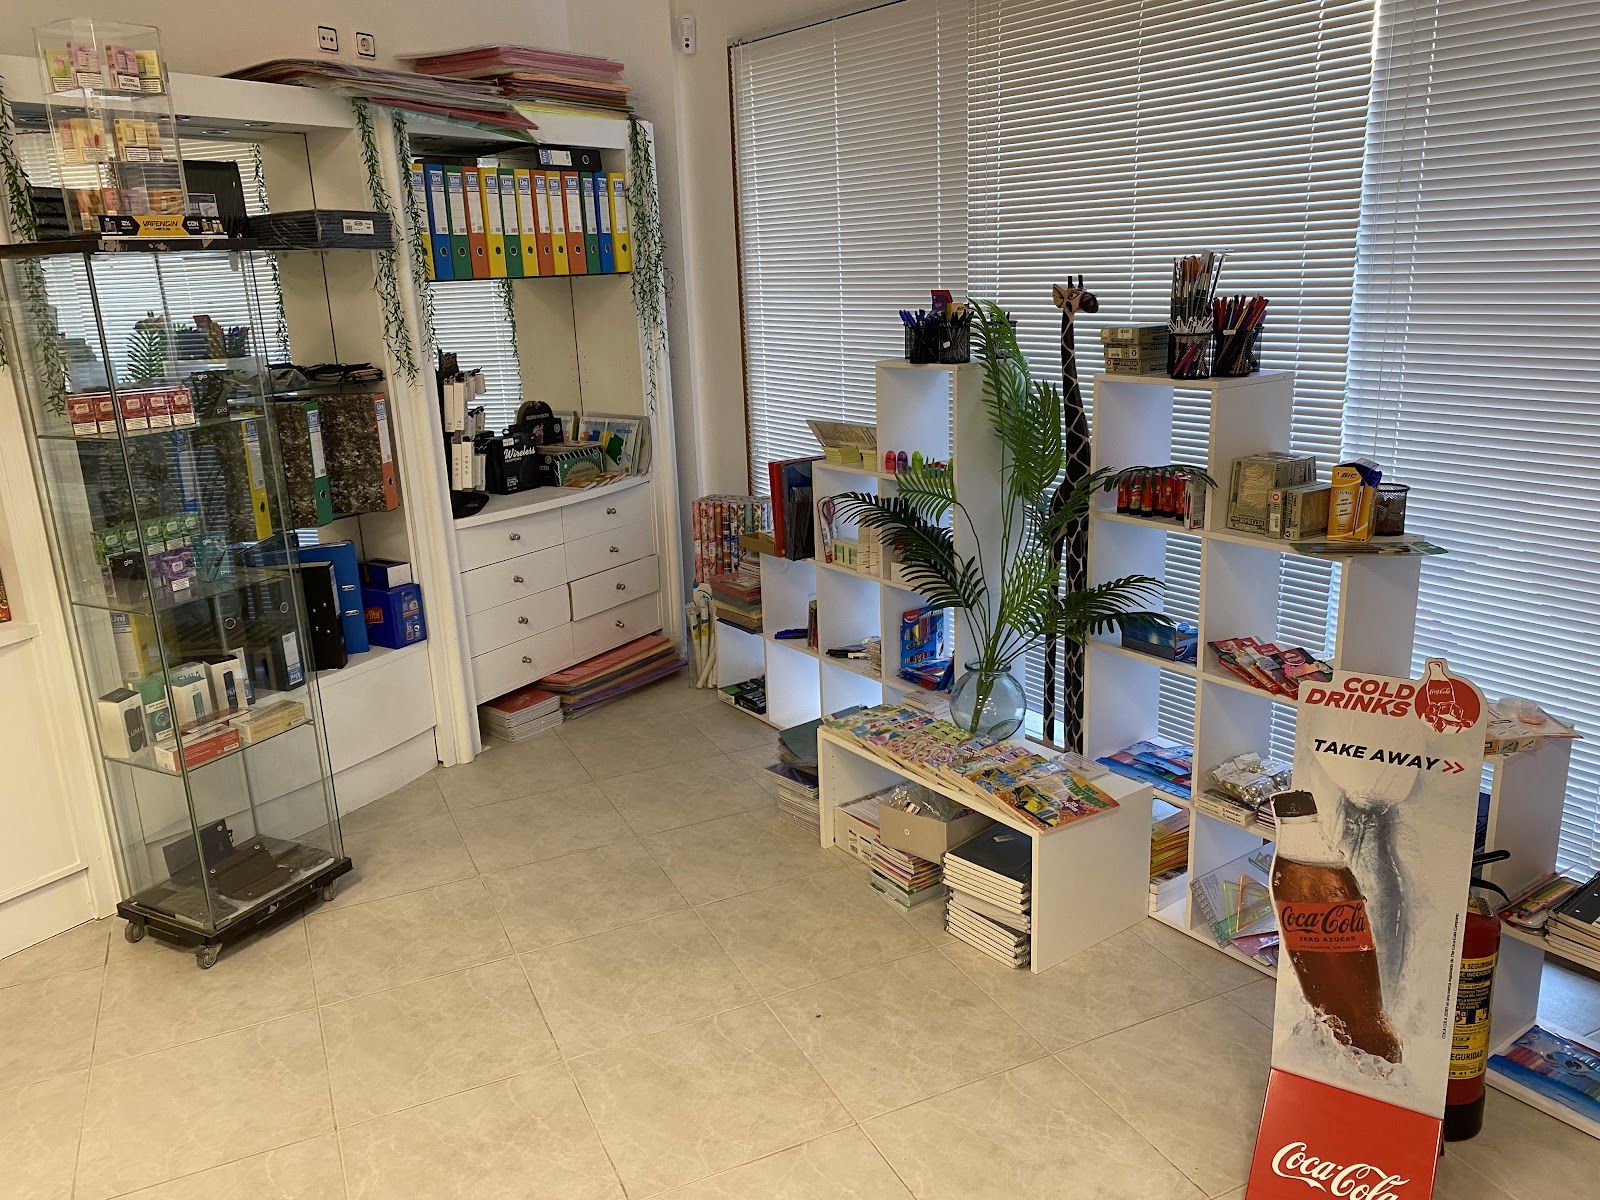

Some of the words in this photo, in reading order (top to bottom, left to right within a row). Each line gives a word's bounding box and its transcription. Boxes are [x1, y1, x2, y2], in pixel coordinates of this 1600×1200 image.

[503, 445, 536, 460] Wireless
[1343, 677, 1416, 700] COLD
[1429, 687, 1451, 696] Coca-Cola
[1304, 688, 1412, 717] DRINKS
[1314, 738, 1367, 759] TAKE
[1369, 749, 1440, 771] AWAY
[1281, 903, 1366, 935] Coca-Cola
[1451, 1049, 1484, 1061] EGURIDAD
[1271, 1142, 1410, 1200] Coca-Cola
